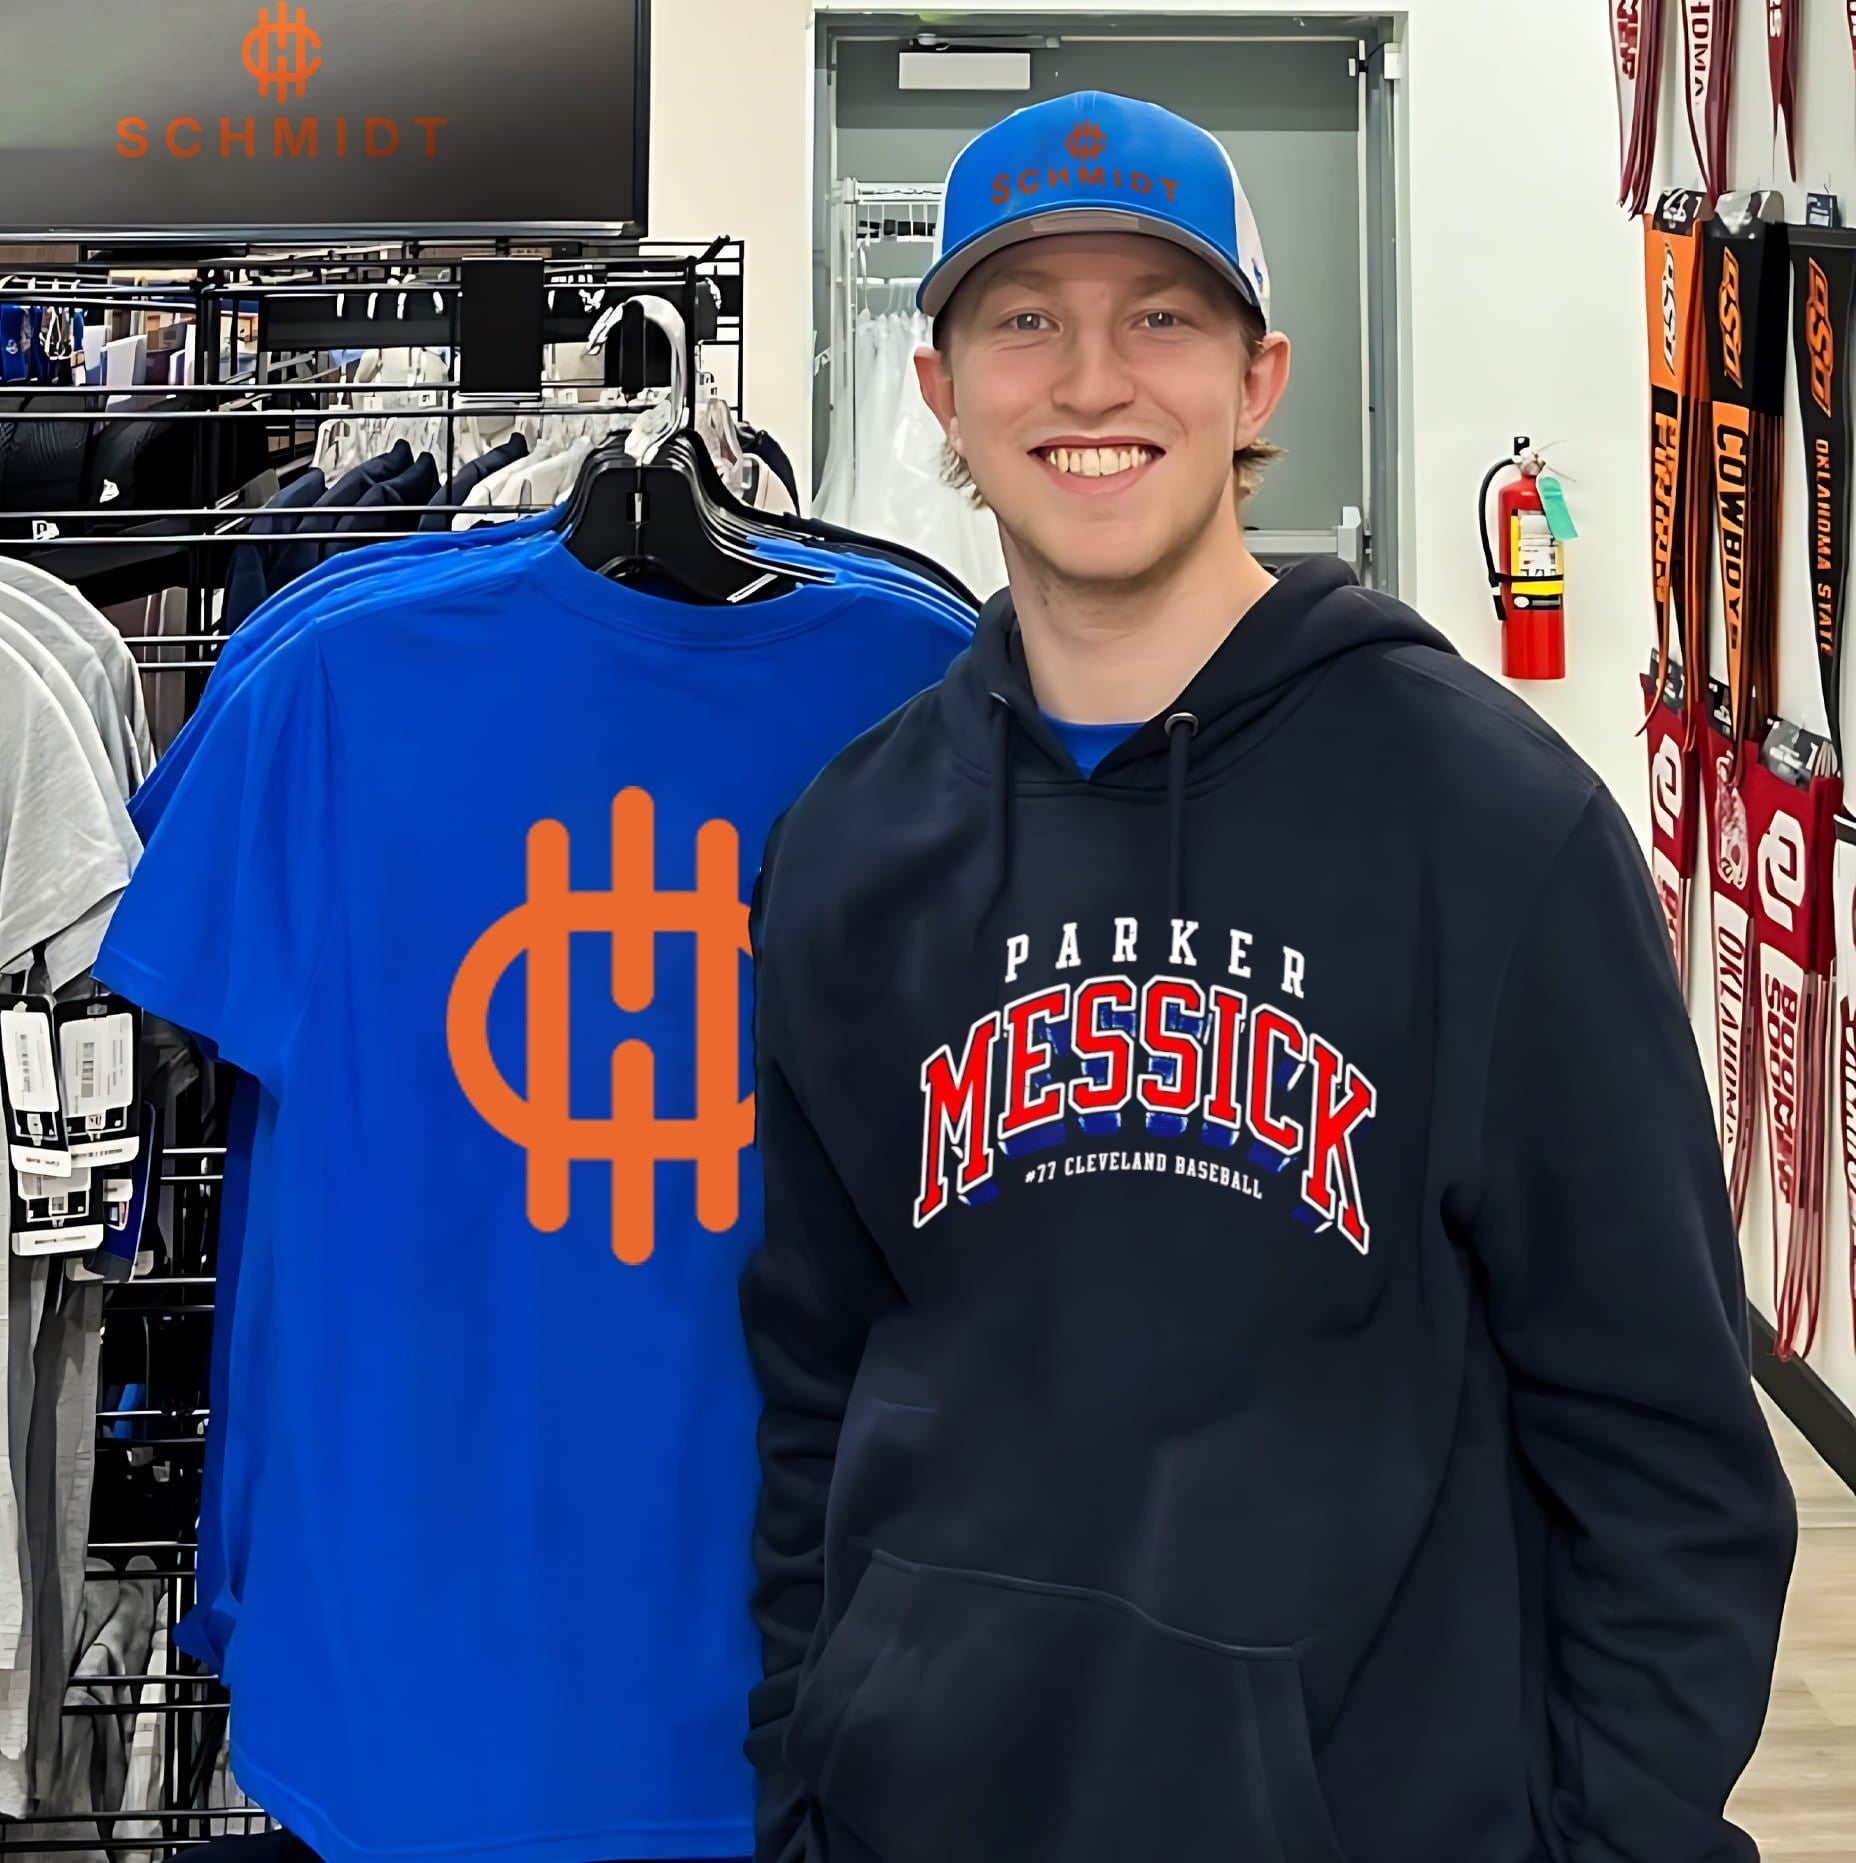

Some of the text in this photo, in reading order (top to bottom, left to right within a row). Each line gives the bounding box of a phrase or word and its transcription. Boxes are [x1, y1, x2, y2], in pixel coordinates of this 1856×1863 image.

[115, 116, 447, 158] SCHMIDT
[991, 166, 1179, 204] SCHMIDT
[1815, 439, 1832, 570] OKLAHOMA
[1004, 917, 1306, 998] PARKER
[1719, 926, 1746, 1144] OKLAHOMA
[913, 974, 1377, 1256] MESSICK
[1025, 1151, 1263, 1199] #77 CLEVELAND BASEBALL
